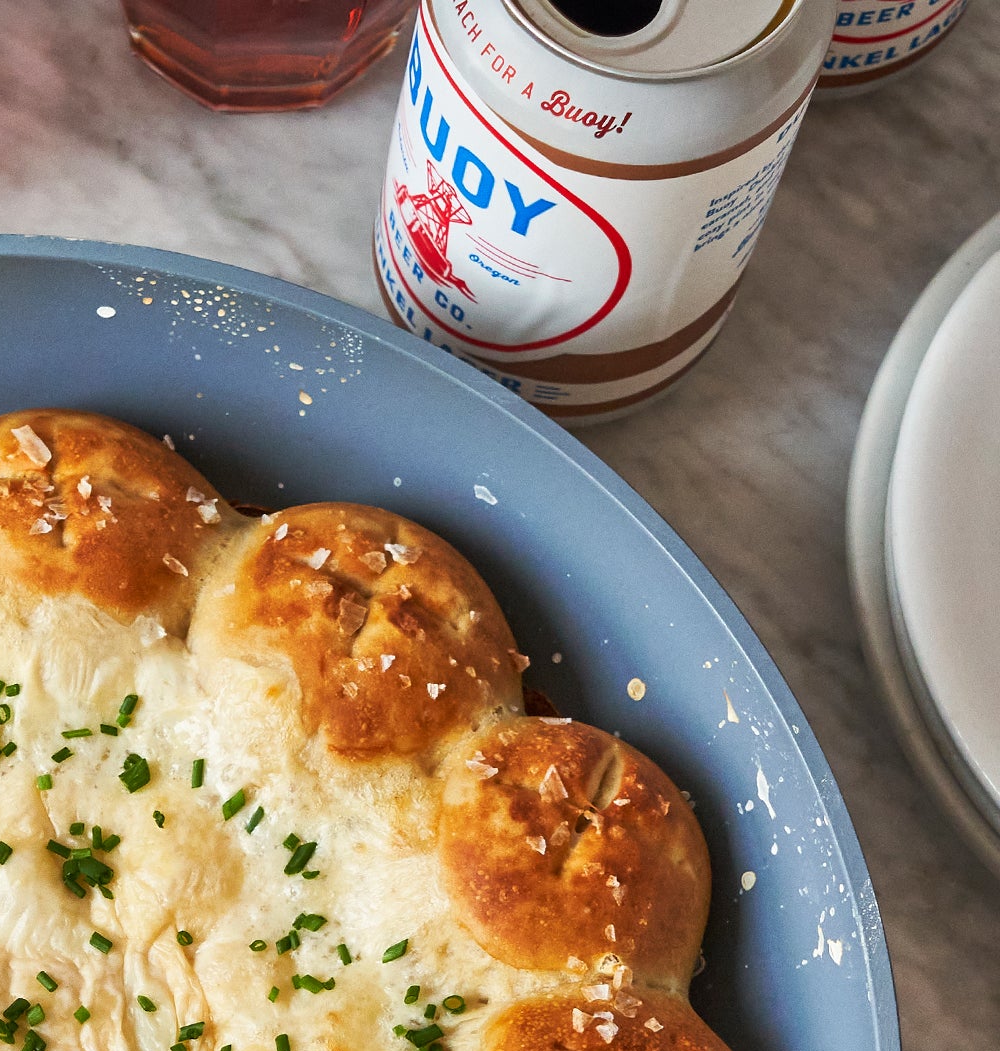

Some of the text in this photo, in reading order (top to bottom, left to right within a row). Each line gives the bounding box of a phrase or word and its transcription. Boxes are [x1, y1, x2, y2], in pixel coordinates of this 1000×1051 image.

[835, 2, 915, 27] BEER
[454, 0, 633, 139] ACH FOR A Buoy!
[408, 26, 557, 237] BUOY
[389, 209, 425, 285] BEER
[468, 253, 521, 287] Oregon
[434, 289, 472, 330] CO.
